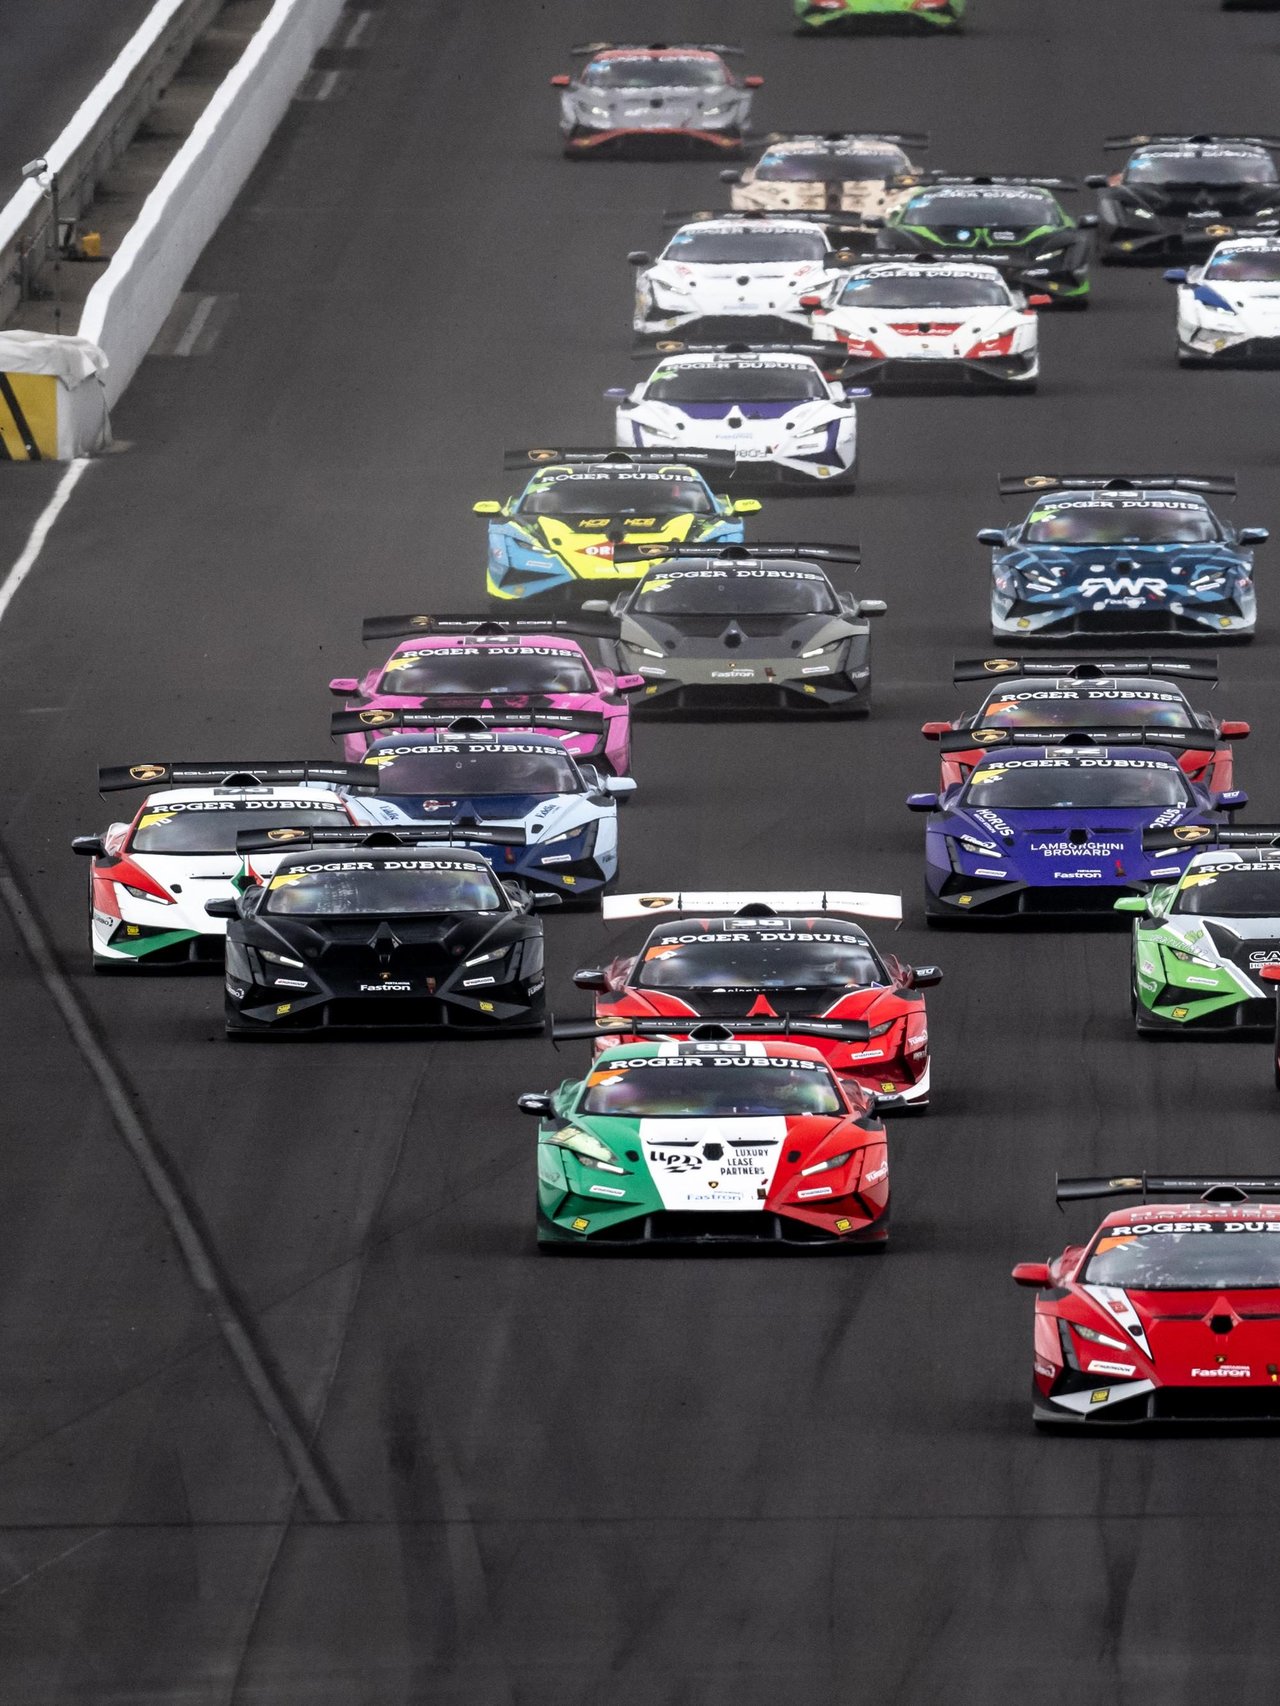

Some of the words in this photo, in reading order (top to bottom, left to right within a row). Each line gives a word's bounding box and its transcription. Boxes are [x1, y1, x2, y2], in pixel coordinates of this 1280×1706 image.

[666, 361, 730, 371] ROGER
[738, 361, 810, 371] DUBUIS
[541, 473, 611, 482] ROGER
[617, 473, 694, 482] DUBUIS
[1044, 501, 1115, 511] ROGER
[1122, 501, 1199, 511] DUBUIS
[655, 570, 728, 580] ROGER
[736, 570, 816, 580] DUBUIS
[402, 648, 479, 659] ROGER
[488, 647, 574, 659] DUBUIS
[1000, 691, 1080, 702] ROGER
[1089, 691, 1175, 702] DUBUIS
[378, 745, 460, 756] ROGER
[469, 744, 558, 756] DUBUIS
[988, 759, 1071, 770] ROGER
[1080, 759, 1170, 771] DUBUIS
[152, 801, 236, 813] ROGER
[245, 801, 337, 812] DUBUIS
[974, 807, 1015, 837] HORUS
[1030, 842, 1125, 851] LAMBORGHINI
[1043, 849, 1112, 857] BROWARD
[288, 862, 375, 874] ROGER
[383, 861, 478, 872] DUBUIS
[1054, 871, 1102, 879] Fastron
[661, 933, 751, 945] ROGER
[760, 933, 859, 944] DUBUIS
[360, 984, 412, 992] Fastron
[608, 1057, 703, 1070] ROGER
[713, 1056, 816, 1070] DUBUIS
[735, 1149, 769, 1157] LUXURY
[727, 1158, 753, 1166] LEASE
[720, 1167, 766, 1175] PARTNERS
[1111, 1222, 1214, 1237] ROGER
[1190, 1367, 1252, 1377] Fastron
